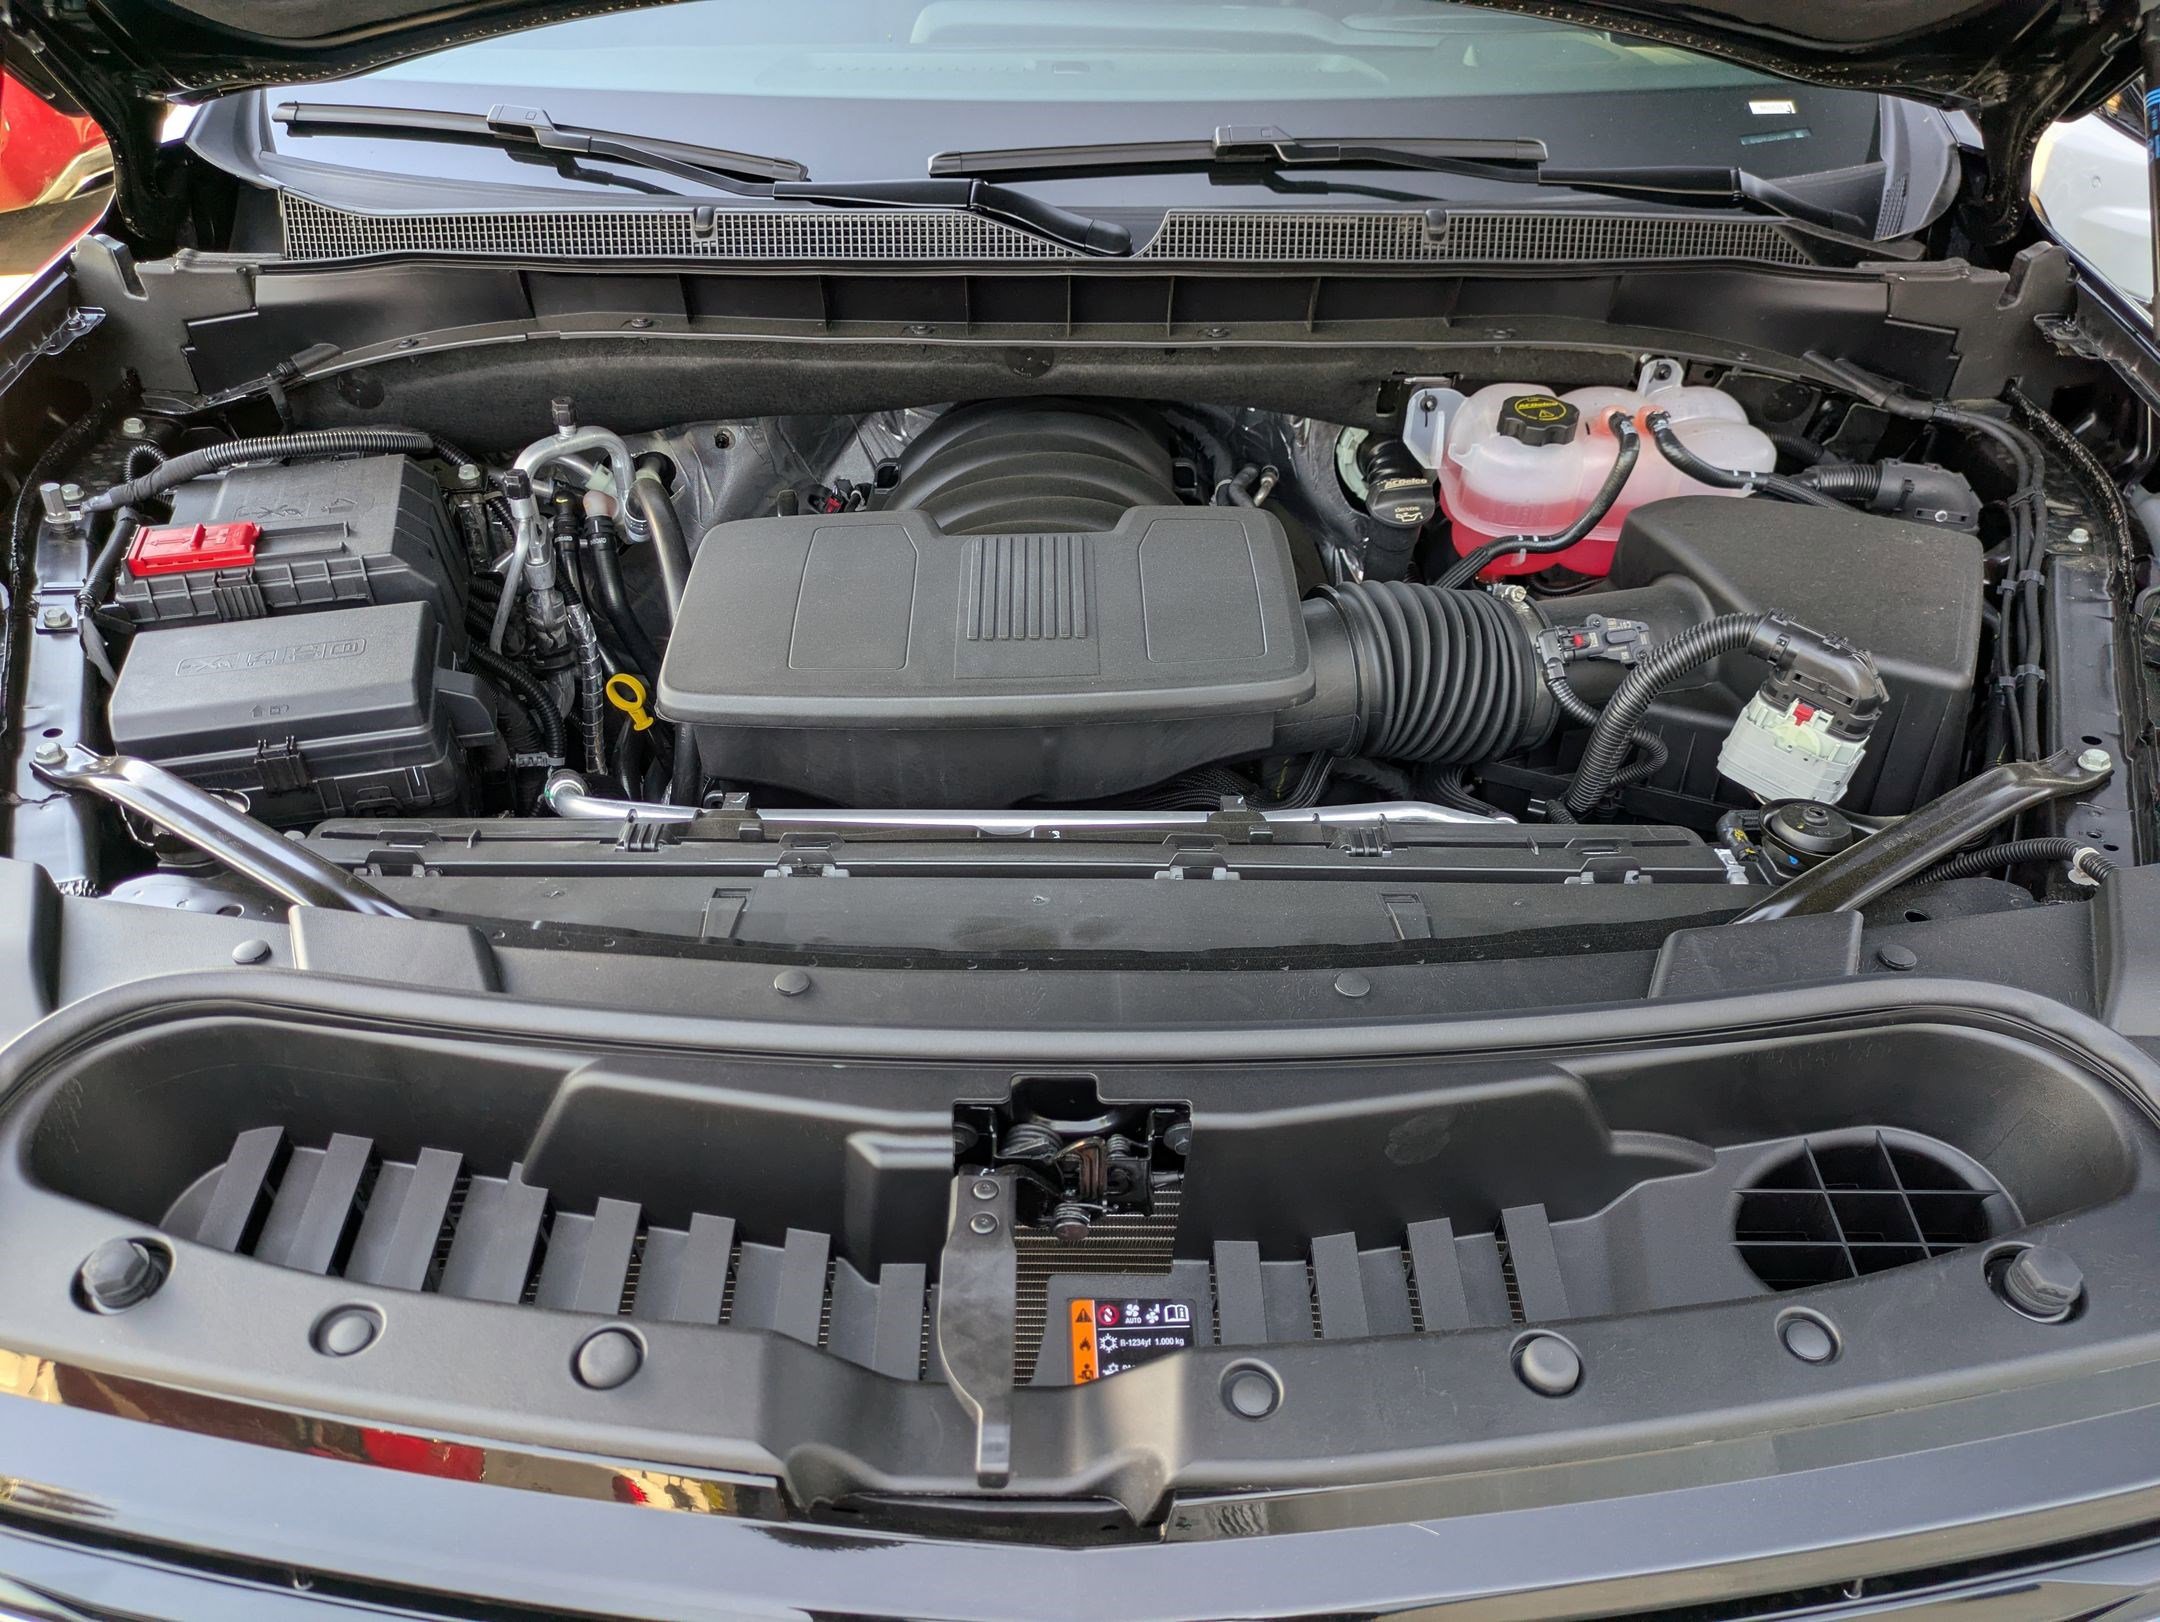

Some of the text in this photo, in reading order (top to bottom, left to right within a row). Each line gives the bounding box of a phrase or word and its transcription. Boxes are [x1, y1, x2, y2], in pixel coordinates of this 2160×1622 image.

[1120, 1337, 1185, 1347] R-1234yf 1.000 kg
